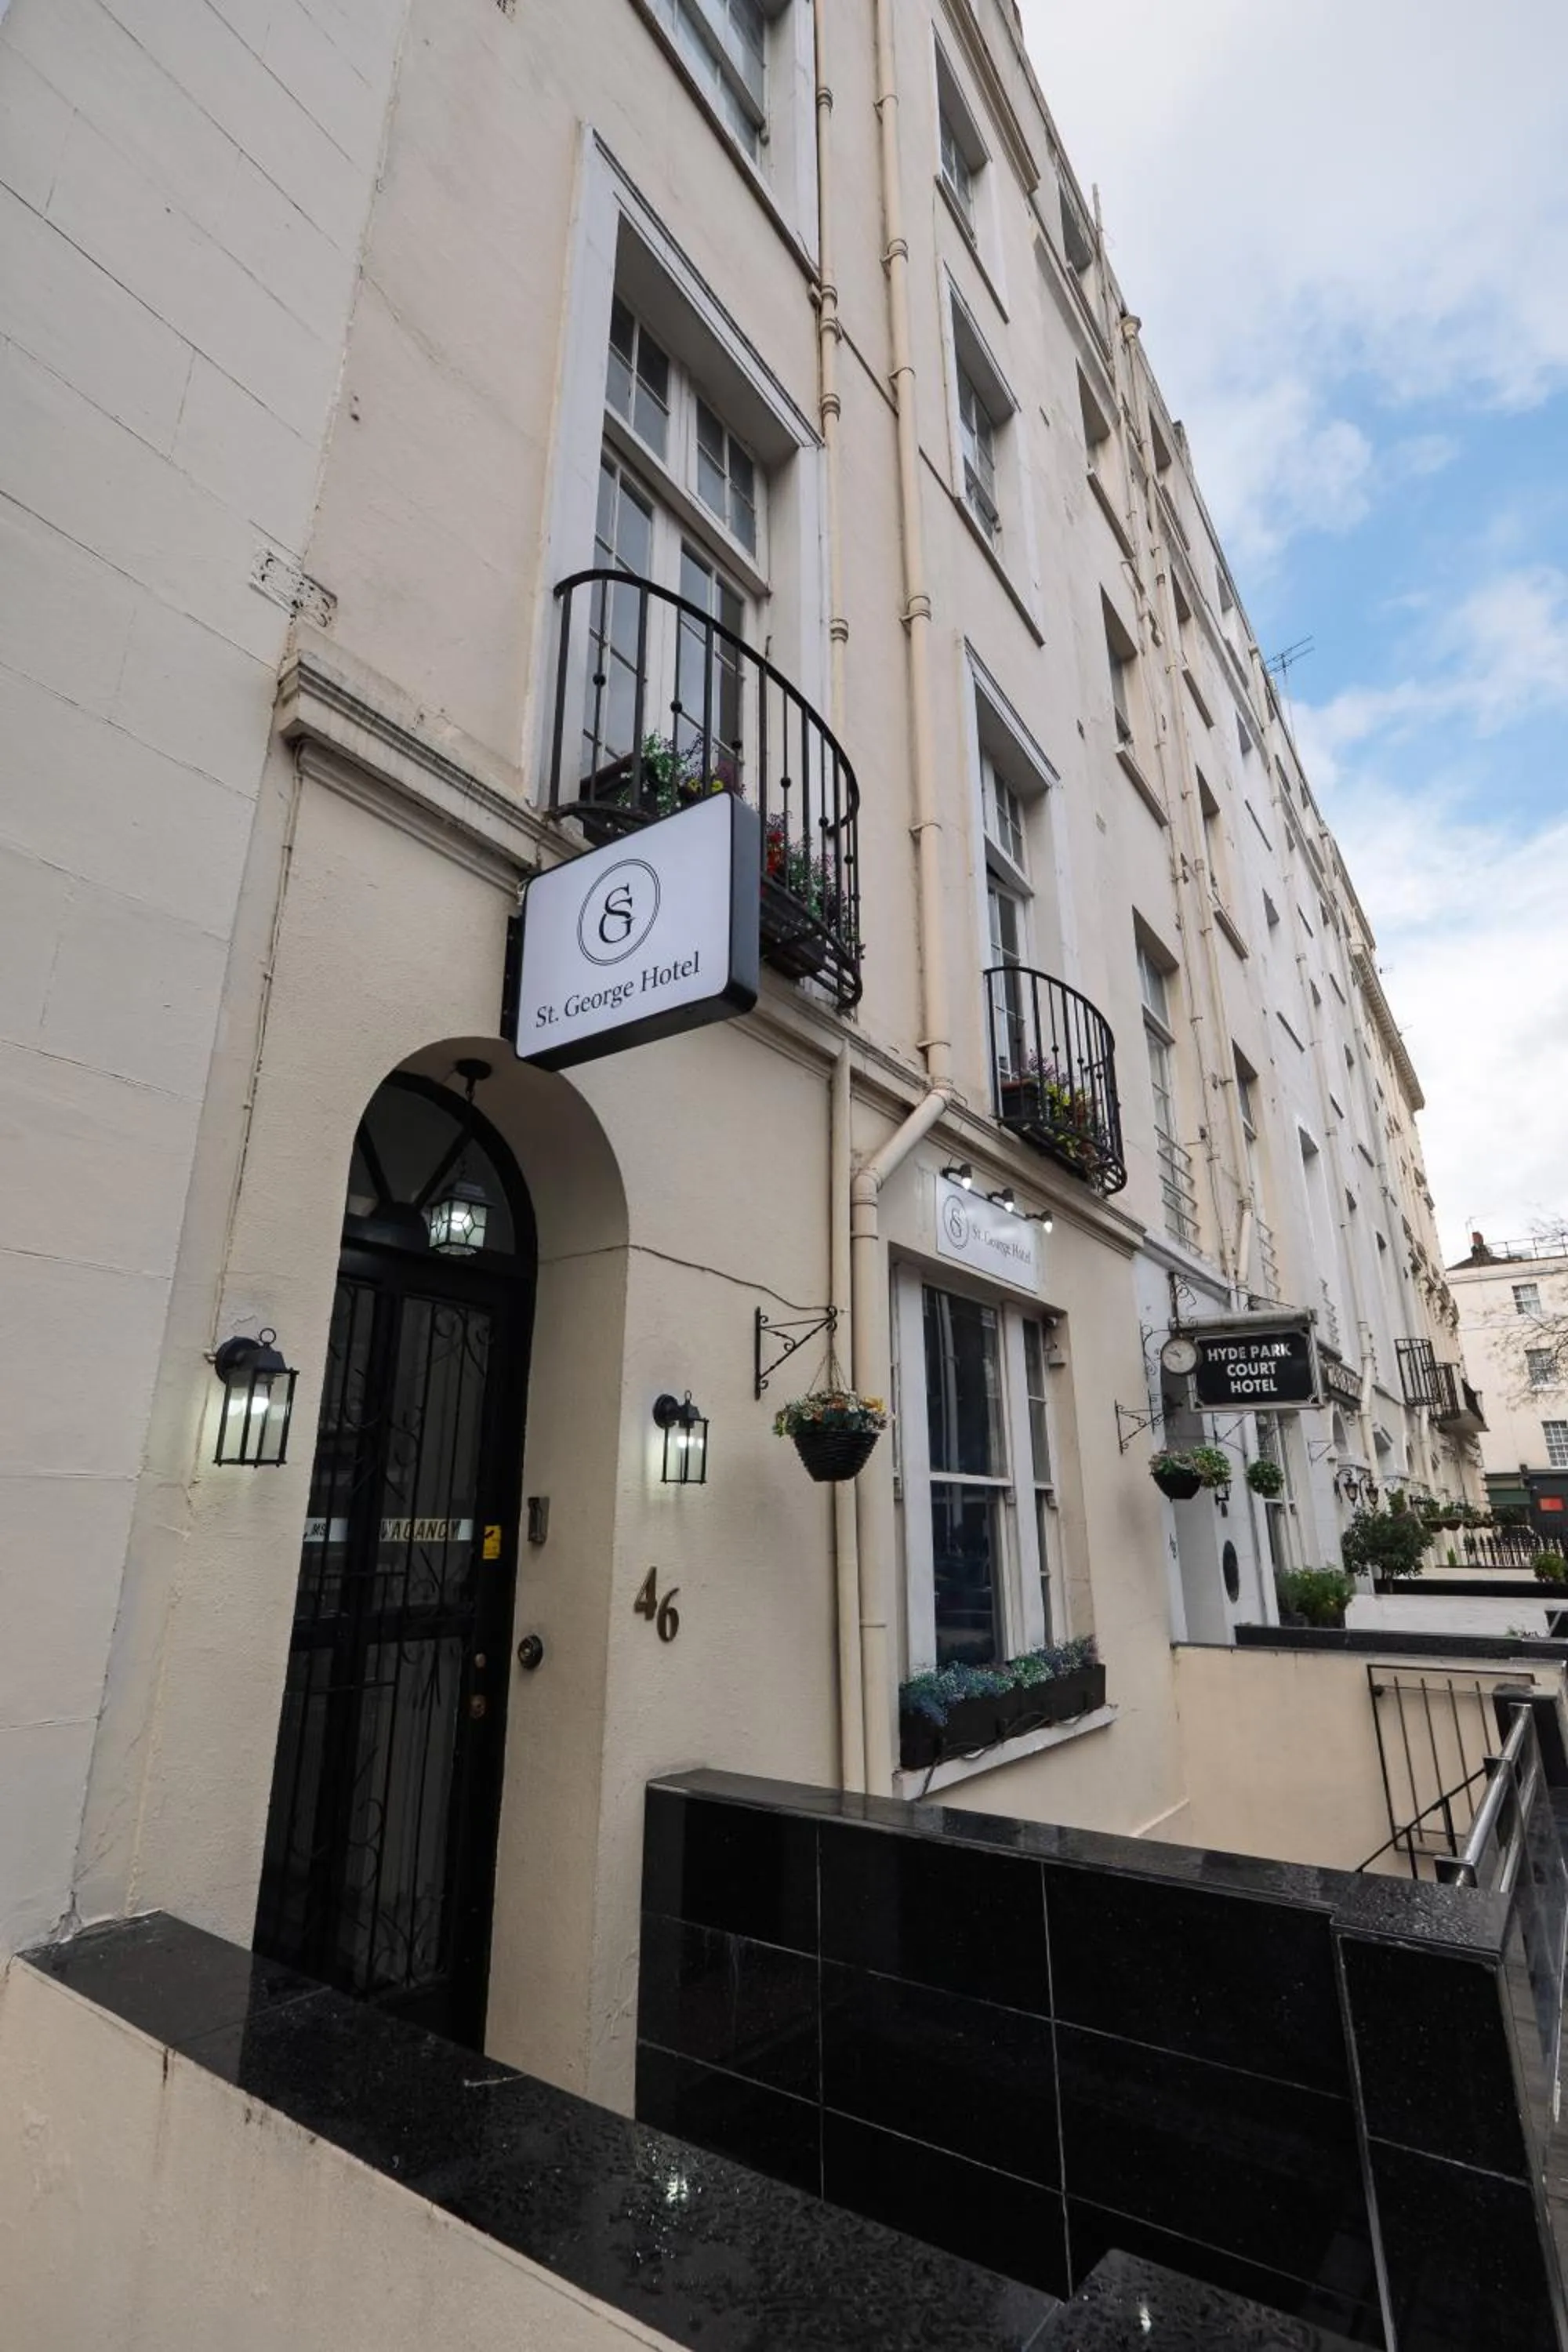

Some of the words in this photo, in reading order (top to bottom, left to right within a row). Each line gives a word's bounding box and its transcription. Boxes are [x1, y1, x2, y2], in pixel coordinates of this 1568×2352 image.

[535, 1005, 559, 1028] St.
[564, 981, 634, 1017] George
[640, 950, 700, 994] Hotel
[1011, 1243, 1031, 1265] Hotel
[1207, 1346, 1247, 1361] HYDE
[1250, 1343, 1292, 1359] PARK
[1227, 1361, 1276, 1377] COURT
[1230, 1378, 1278, 1393] HOTEL
[633, 1566, 680, 1642] 46
